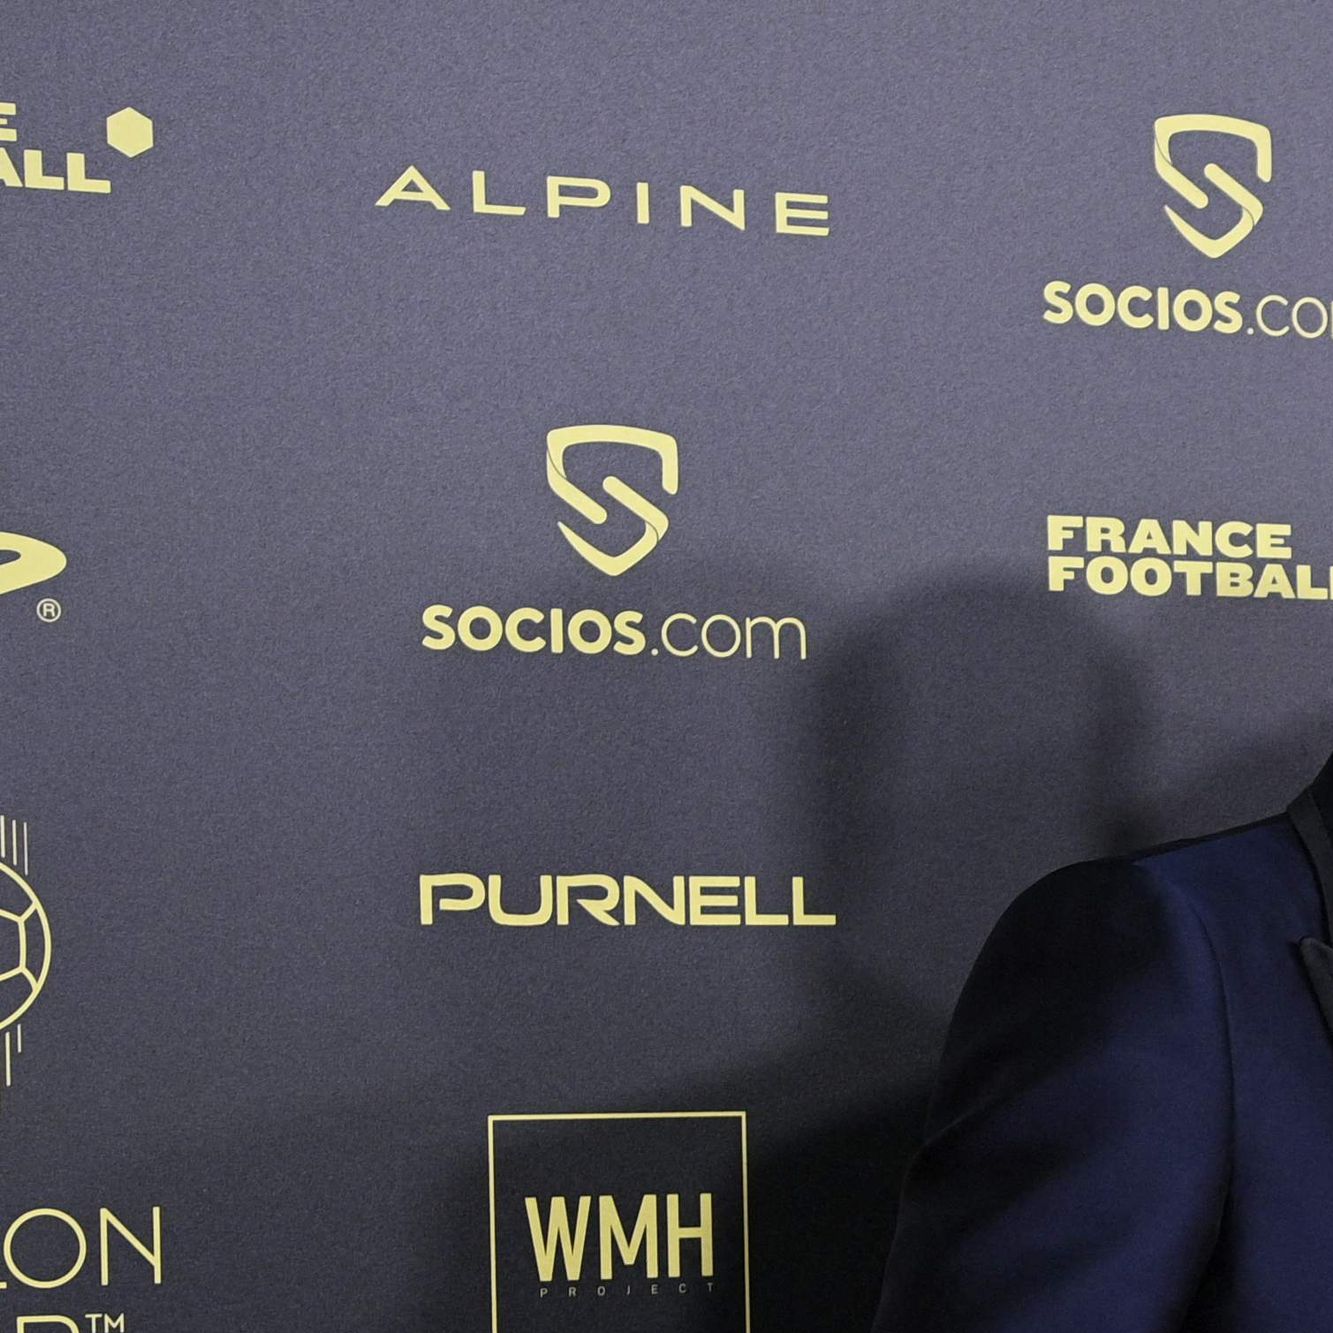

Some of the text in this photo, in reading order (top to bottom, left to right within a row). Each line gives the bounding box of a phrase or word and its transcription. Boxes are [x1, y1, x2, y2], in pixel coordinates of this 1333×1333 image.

[376, 166, 829, 236] ALPINE
[1047, 515, 1291, 560] FRANCE
[422, 605, 806, 659] SOCIOS.com
[420, 873, 836, 926] PURNELL
[525, 1193, 712, 1281] WMH
[540, 1283, 712, 1297] PROJECT
